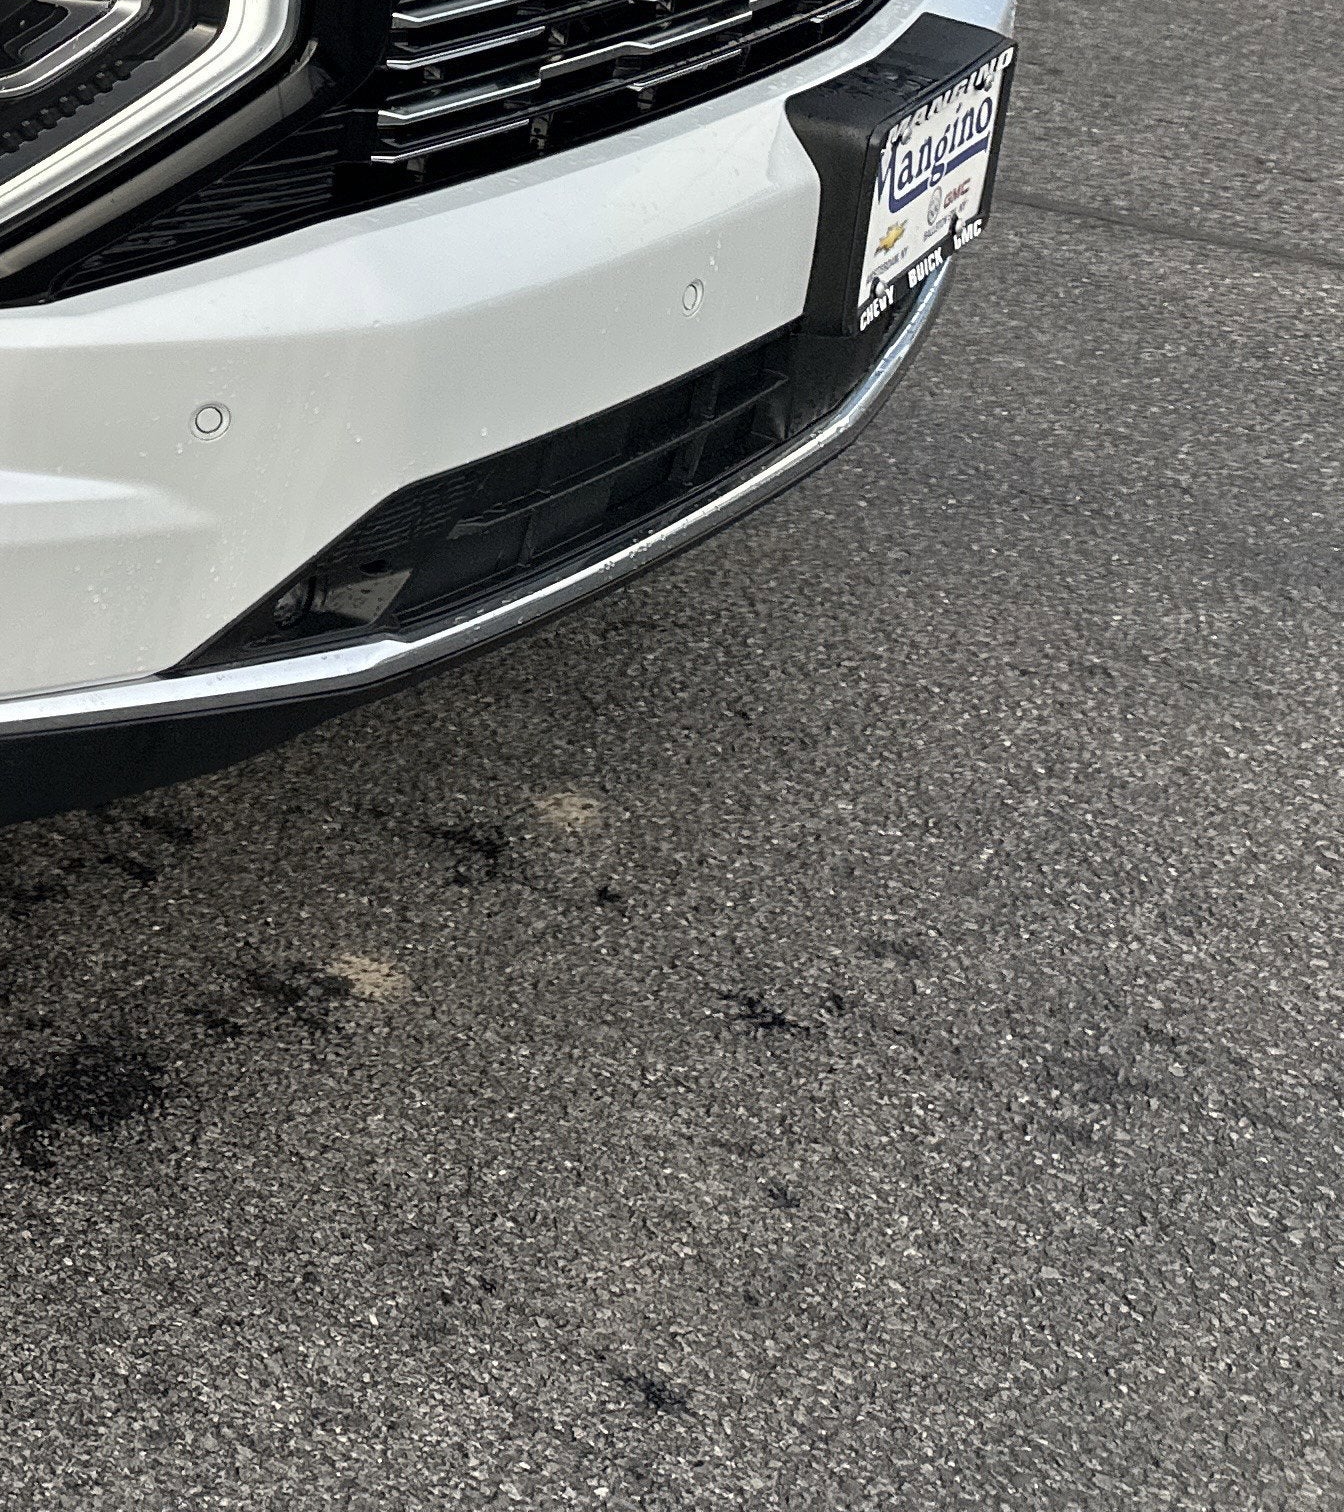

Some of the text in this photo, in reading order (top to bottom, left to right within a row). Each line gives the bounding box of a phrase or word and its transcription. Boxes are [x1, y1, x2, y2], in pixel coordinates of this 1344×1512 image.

[878, 96, 993, 212] Mangino
[860, 285, 895, 332] CHEVY
[907, 246, 944, 289] BUICK
[953, 218, 983, 251] GMC
